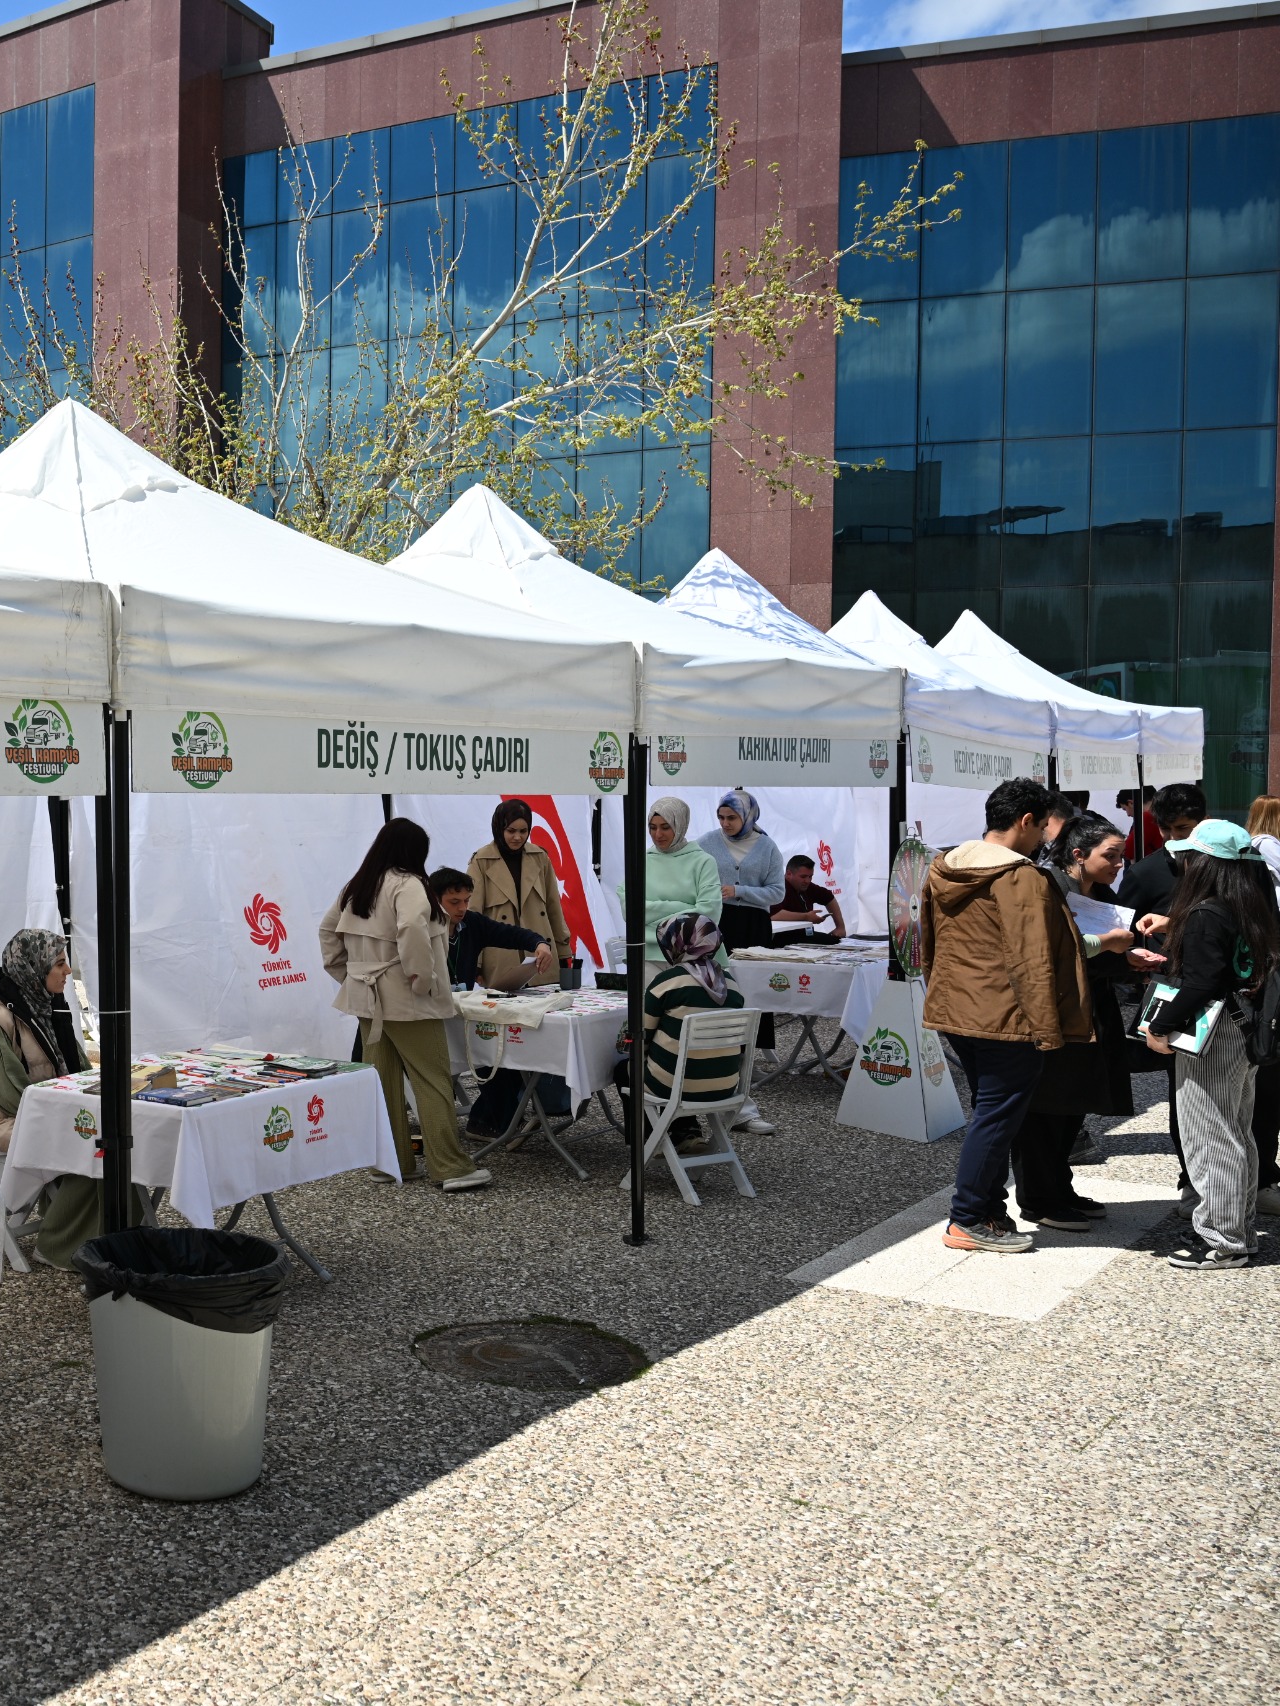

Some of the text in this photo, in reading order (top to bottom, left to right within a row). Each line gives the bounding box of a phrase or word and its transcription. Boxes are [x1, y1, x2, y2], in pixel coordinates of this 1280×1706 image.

[317, 720, 529, 780] DEĞİŞ / TOKUŞ ÇADIRI
[261, 957, 292, 973] TÜRKİYE
[258, 975, 282, 991] ÇEVRE
